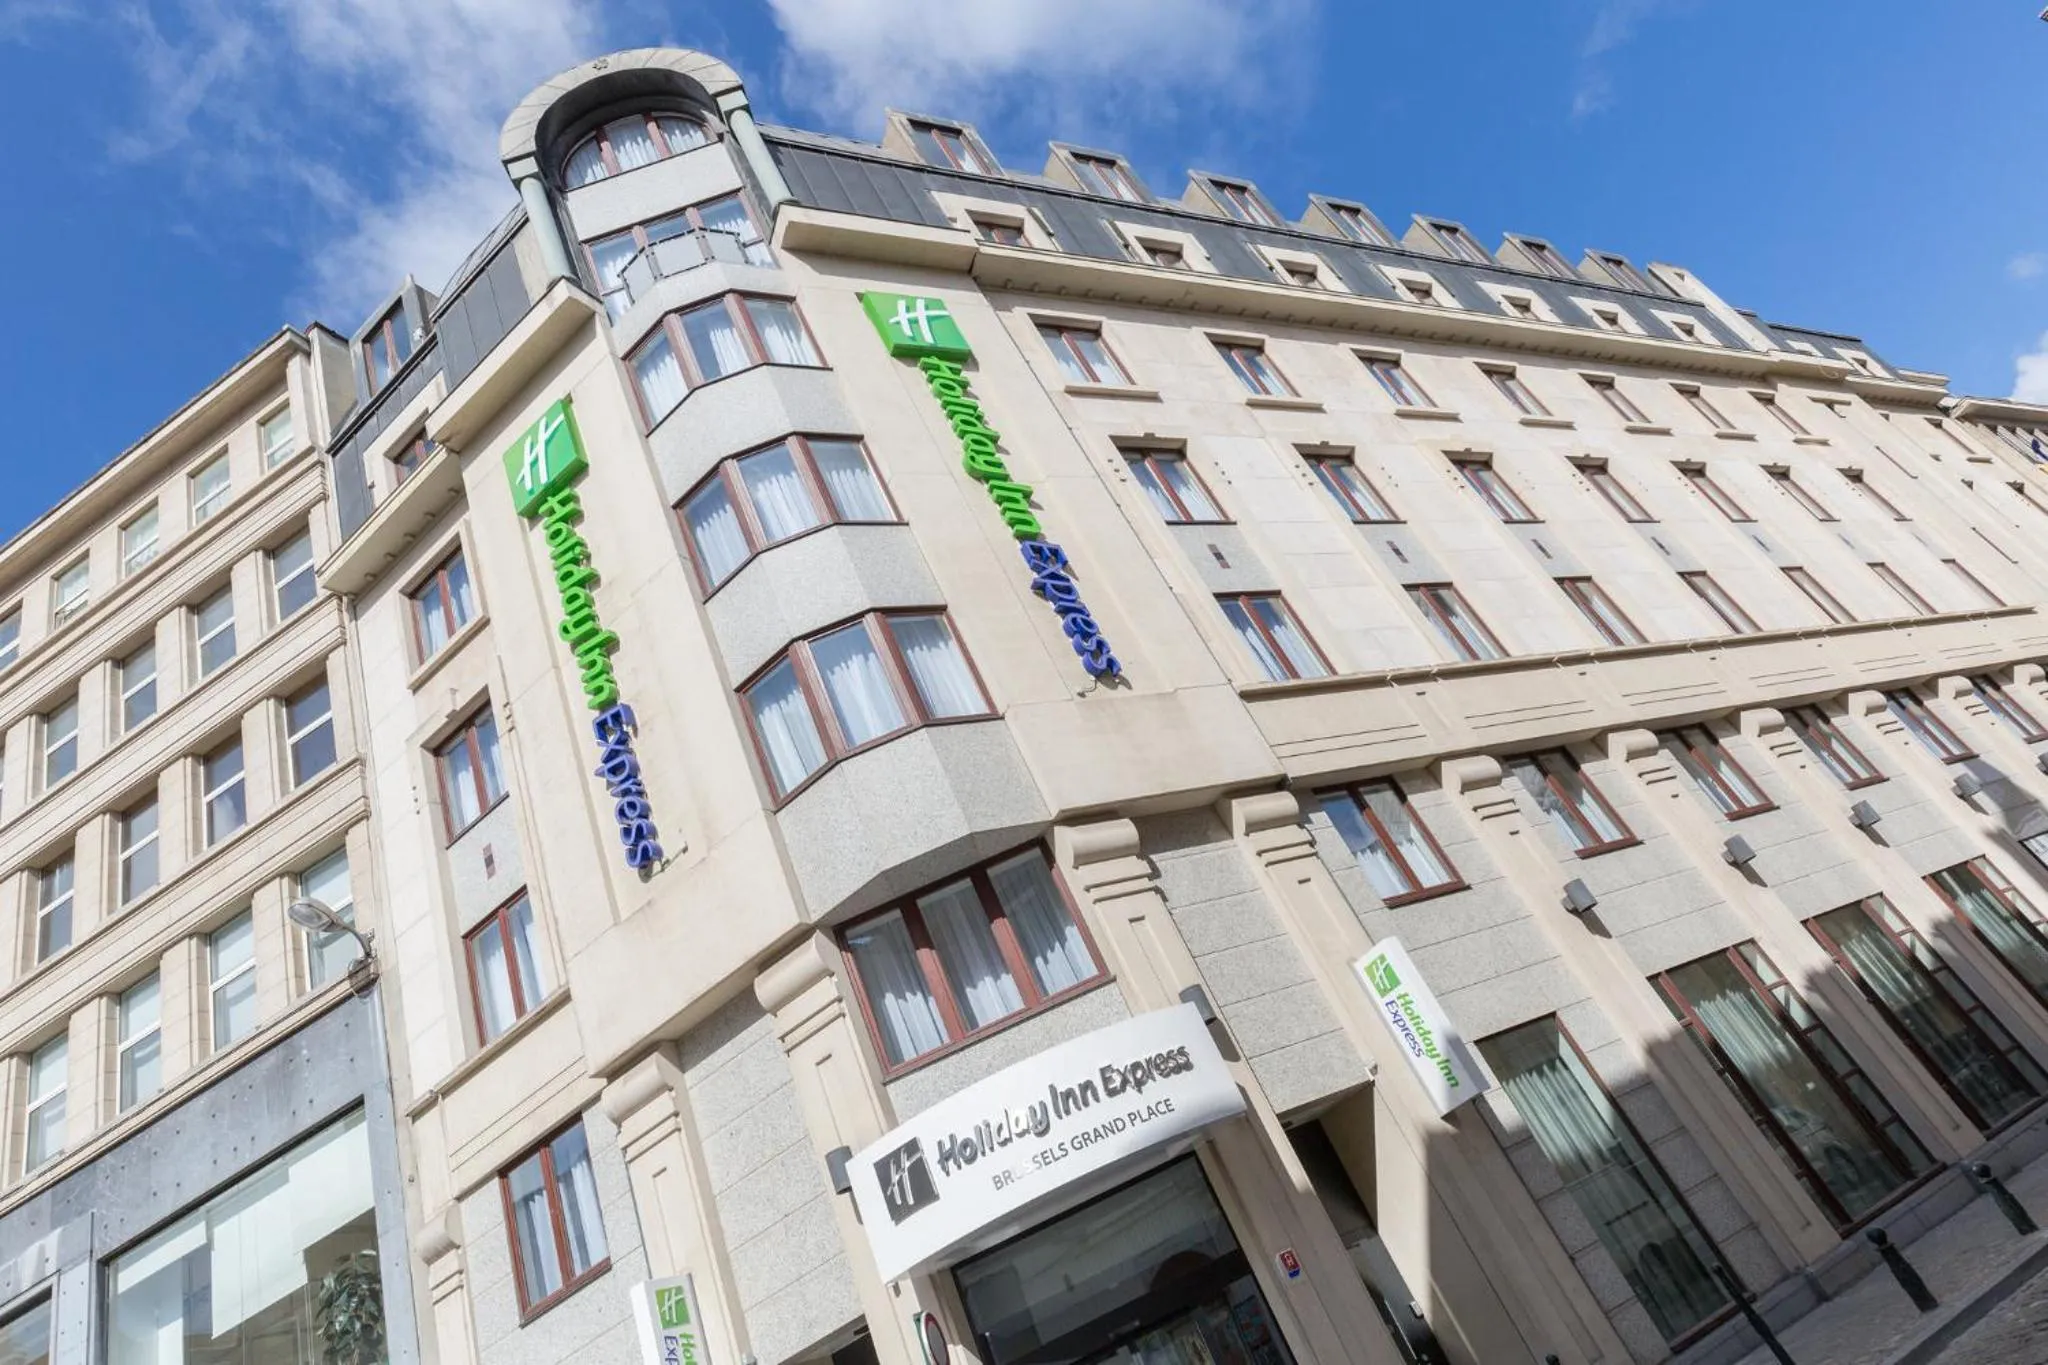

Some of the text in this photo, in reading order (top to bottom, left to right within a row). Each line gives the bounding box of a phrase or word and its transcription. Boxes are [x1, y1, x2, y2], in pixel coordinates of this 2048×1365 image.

[919, 356, 1122, 678] Holiday Inn Express
[539, 486, 663, 869] Holiday Inn Express
[1385, 999, 1425, 1058] Express
[1396, 991, 1460, 1089] Holiday Inn
[936, 1043, 1194, 1177] Holiday Inn Express
[1070, 1117, 1127, 1153] GRAND
[1126, 1097, 1176, 1128] PLACE
